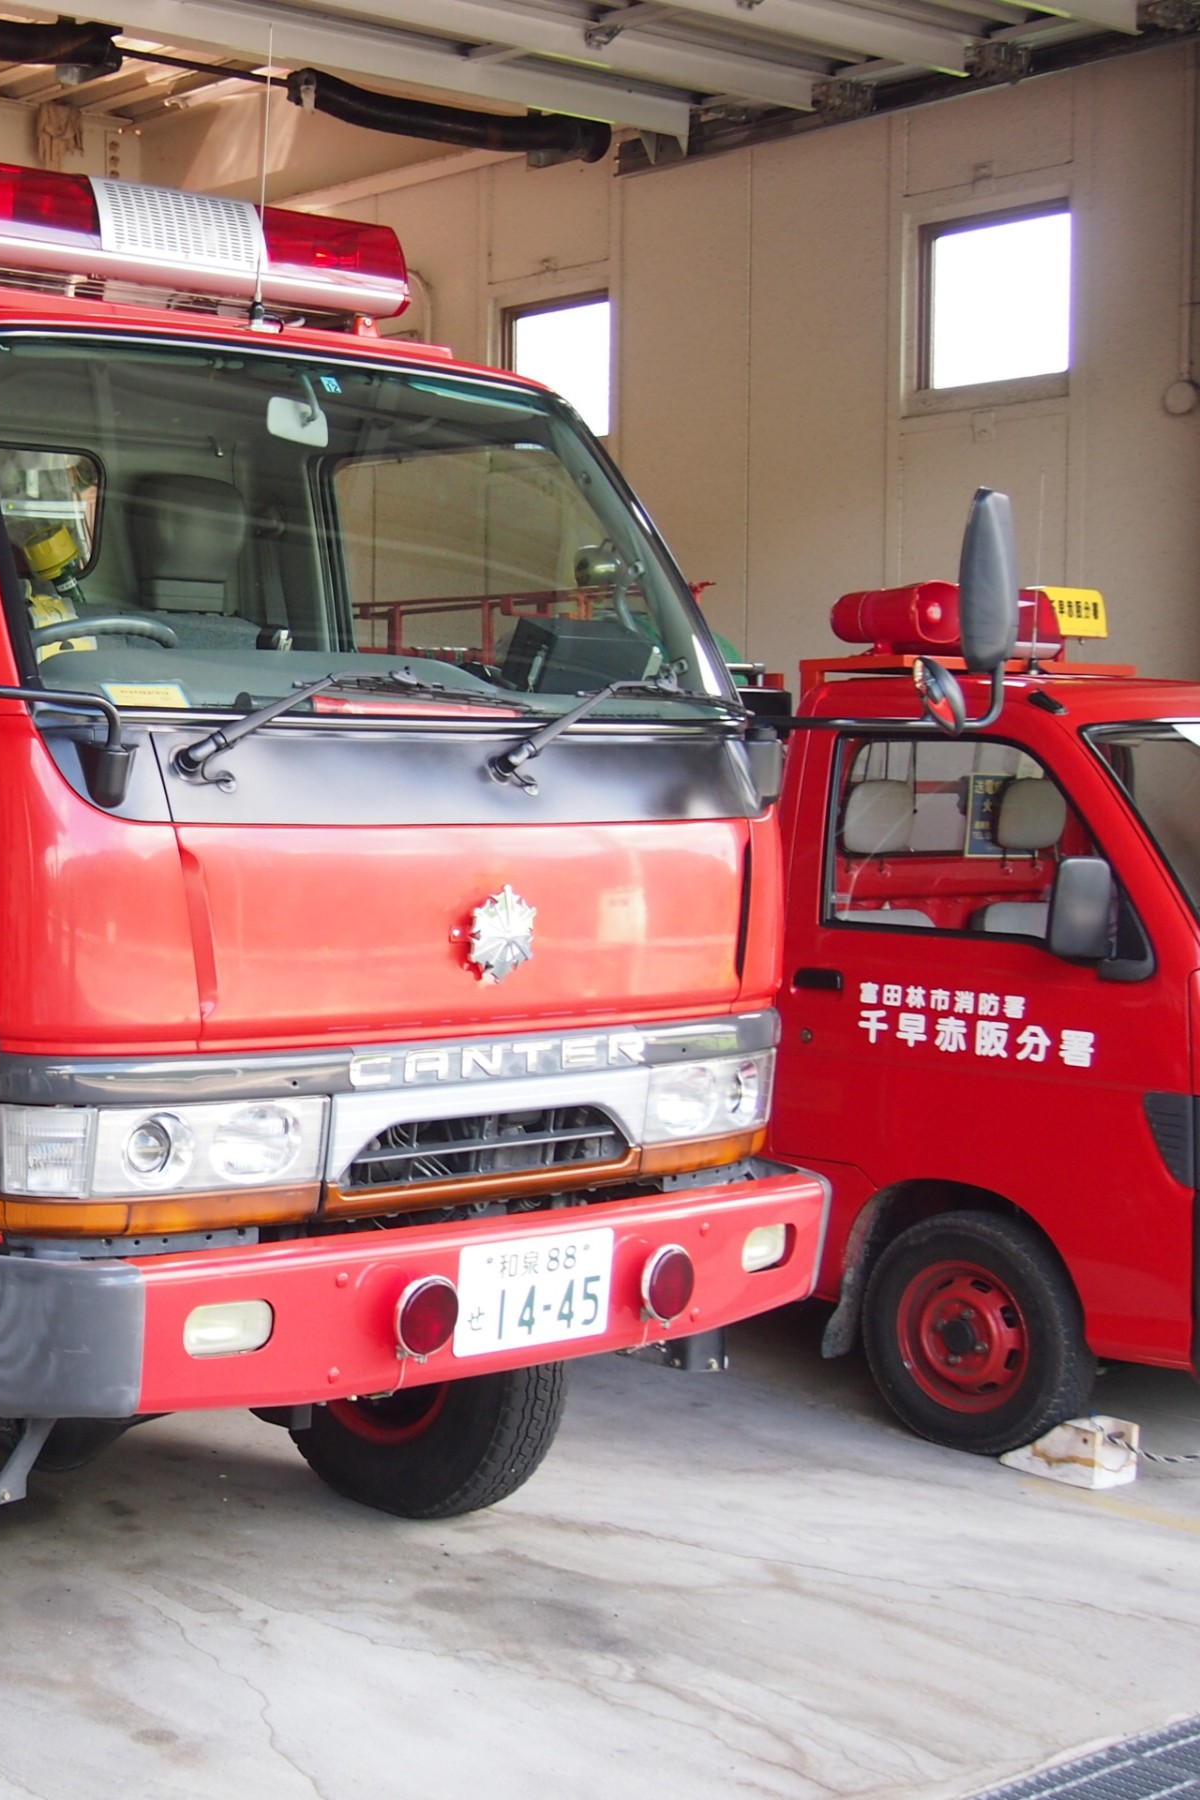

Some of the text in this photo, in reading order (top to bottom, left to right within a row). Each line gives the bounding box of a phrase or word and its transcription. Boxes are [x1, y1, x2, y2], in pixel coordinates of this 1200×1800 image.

[1050, 600, 1099, 620] 早赤阪分署
[860, 982, 1026, 1019] 富田林市消防署
[350, 1032, 646, 1087] CANTER
[858, 1010, 1094, 1068] 千早赤阪分署
[546, 1245, 576, 1272] 88
[467, 1275, 601, 1340] せ 14-45
